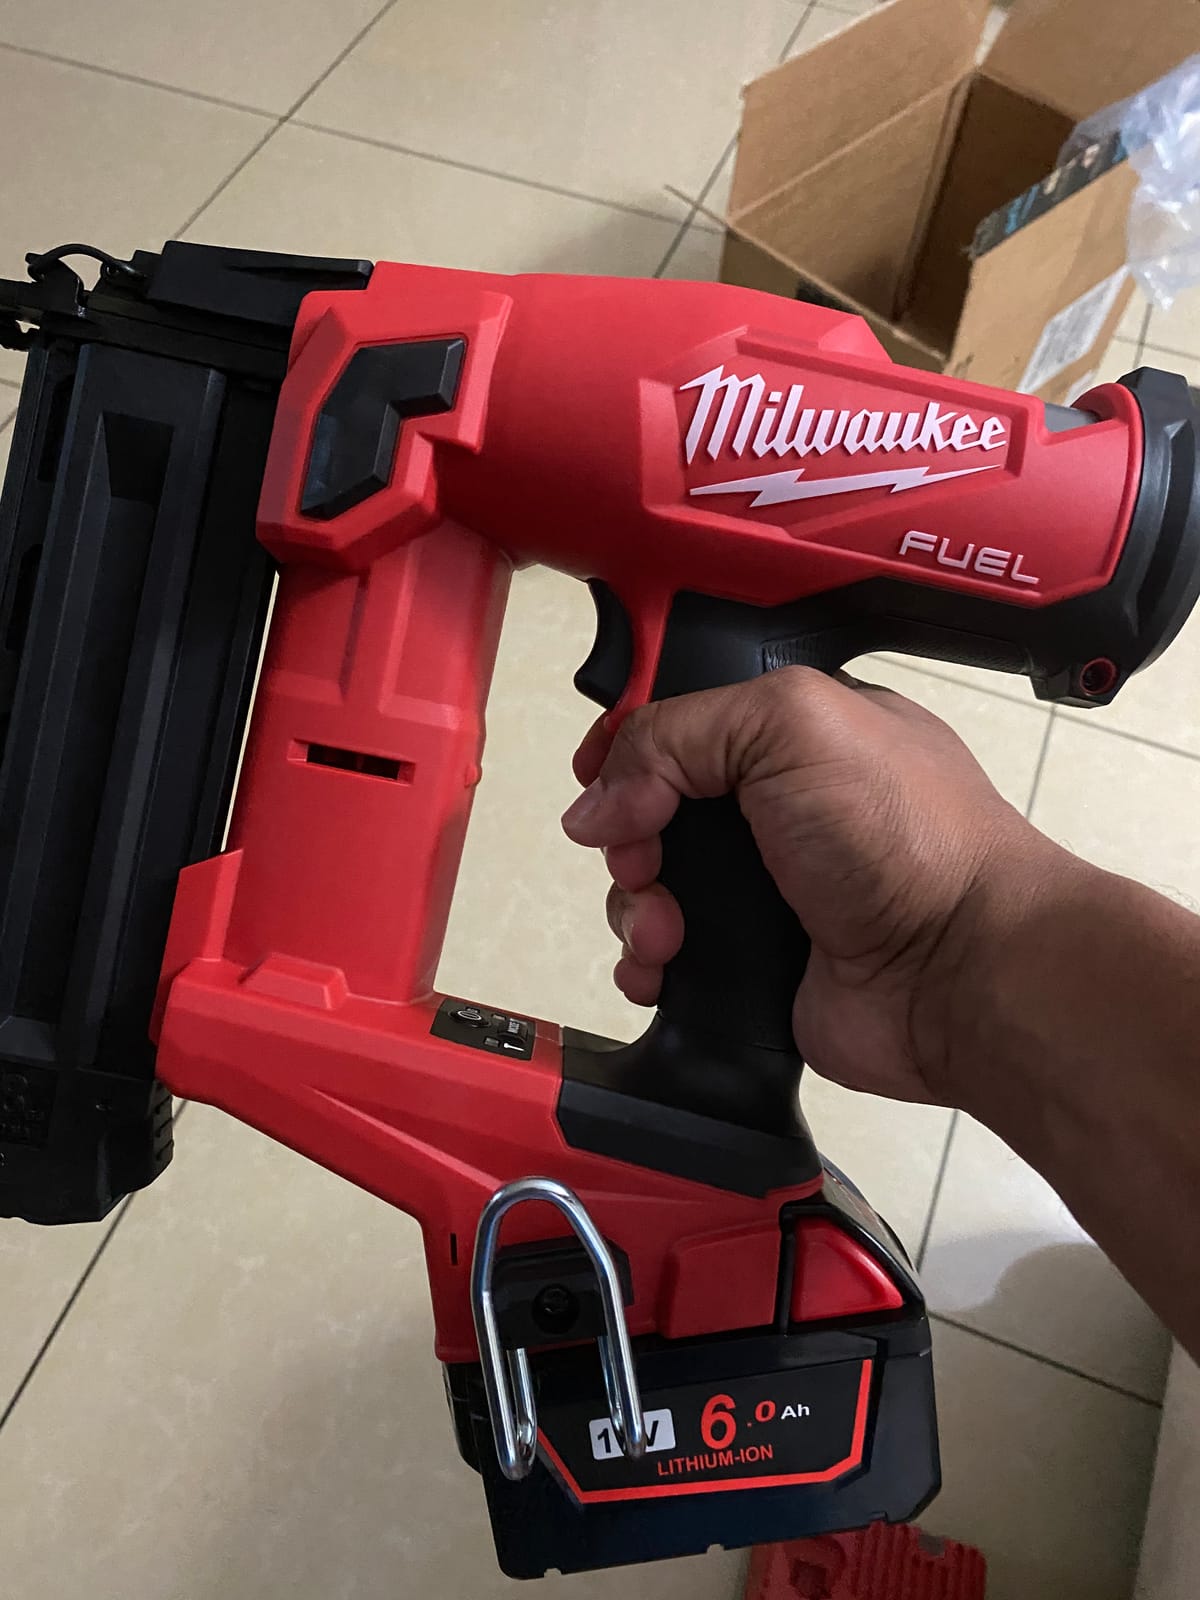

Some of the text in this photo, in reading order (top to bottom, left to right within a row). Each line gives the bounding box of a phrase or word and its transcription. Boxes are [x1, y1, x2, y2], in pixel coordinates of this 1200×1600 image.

[680, 365, 1007, 464] Milwaukee
[899, 530, 1039, 584] FUEL
[597, 1420, 659, 1454] 1V
[781, 1404, 810, 1420] Ah
[657, 1444, 774, 1476] LITHIUM-ION
